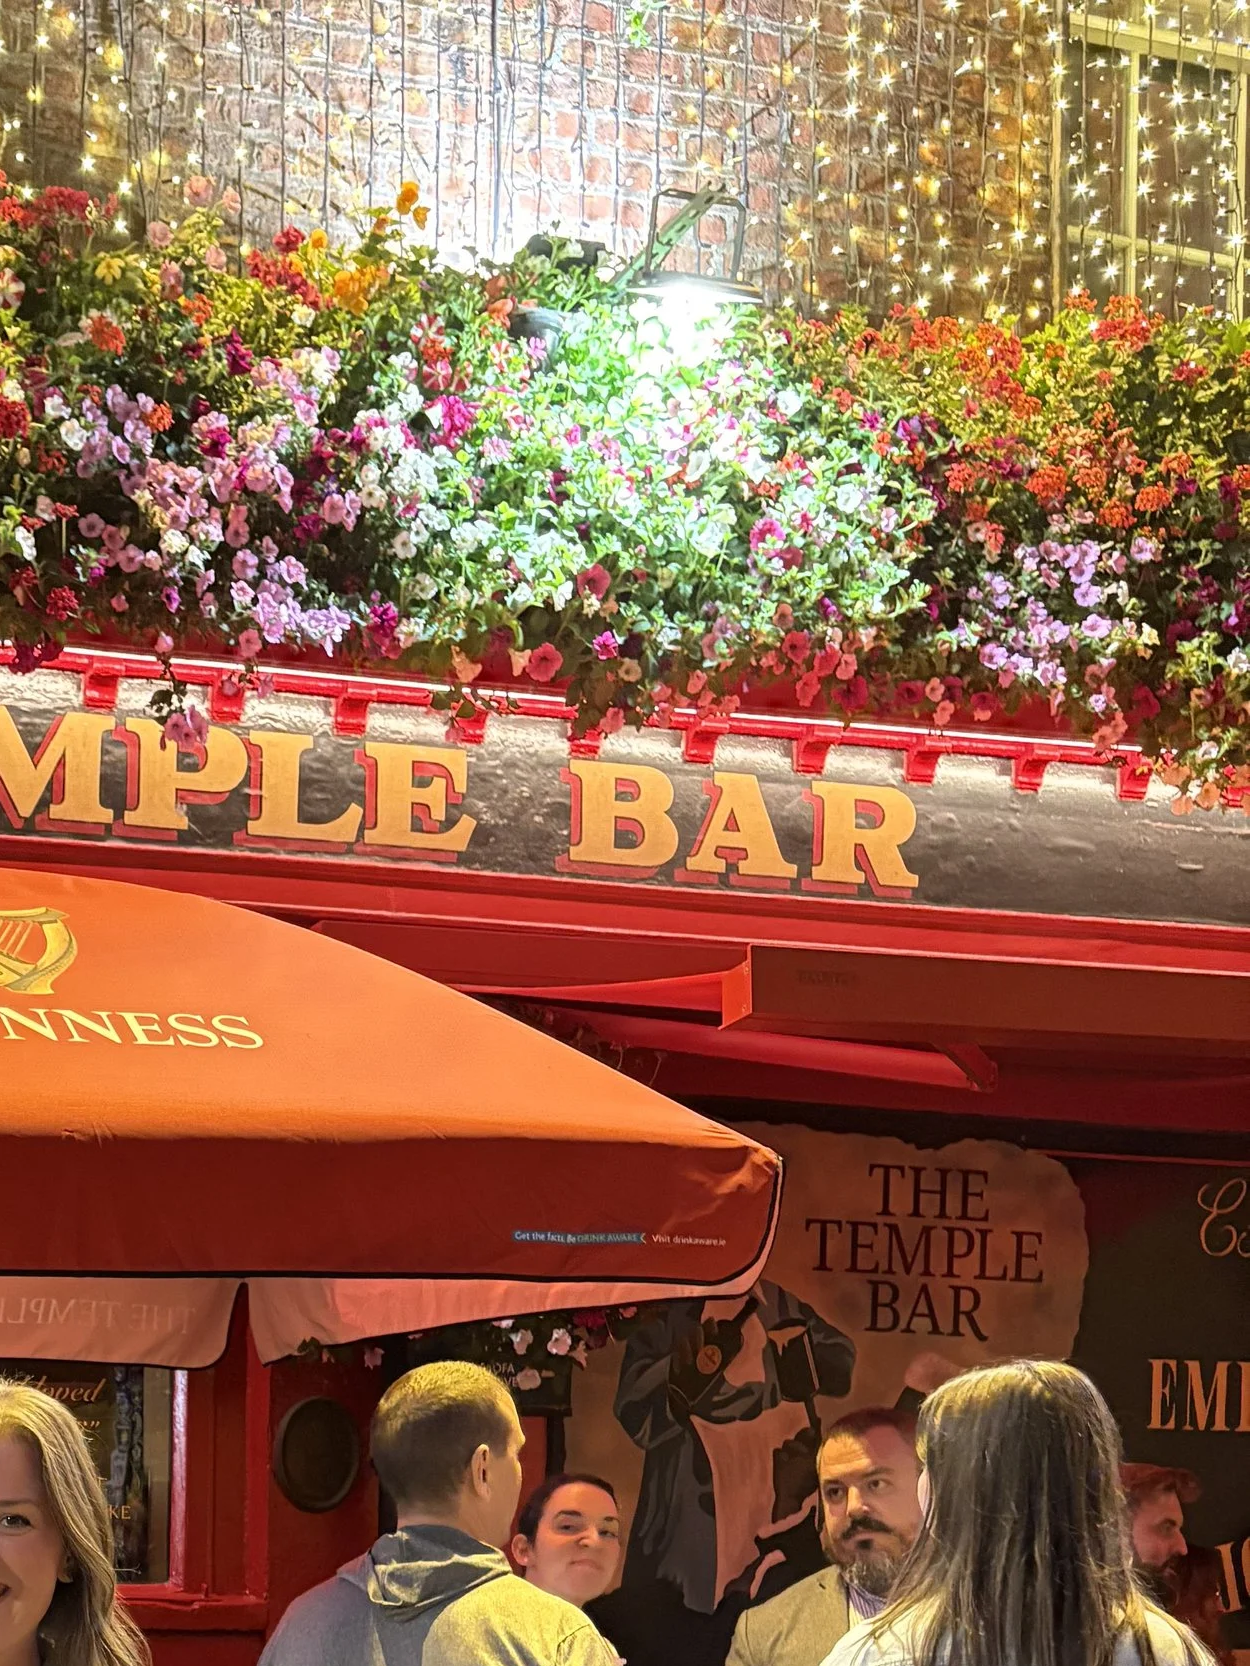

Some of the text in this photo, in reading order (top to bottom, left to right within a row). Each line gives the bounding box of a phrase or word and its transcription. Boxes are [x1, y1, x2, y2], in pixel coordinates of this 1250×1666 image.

[556, 758, 919, 900] BAR
[868, 1163, 990, 1222] THE
[514, 1231, 530, 1241] Get
[532, 1231, 545, 1241] the
[805, 1218, 1044, 1284] TEMPLE
[865, 1280, 989, 1343] BAR
